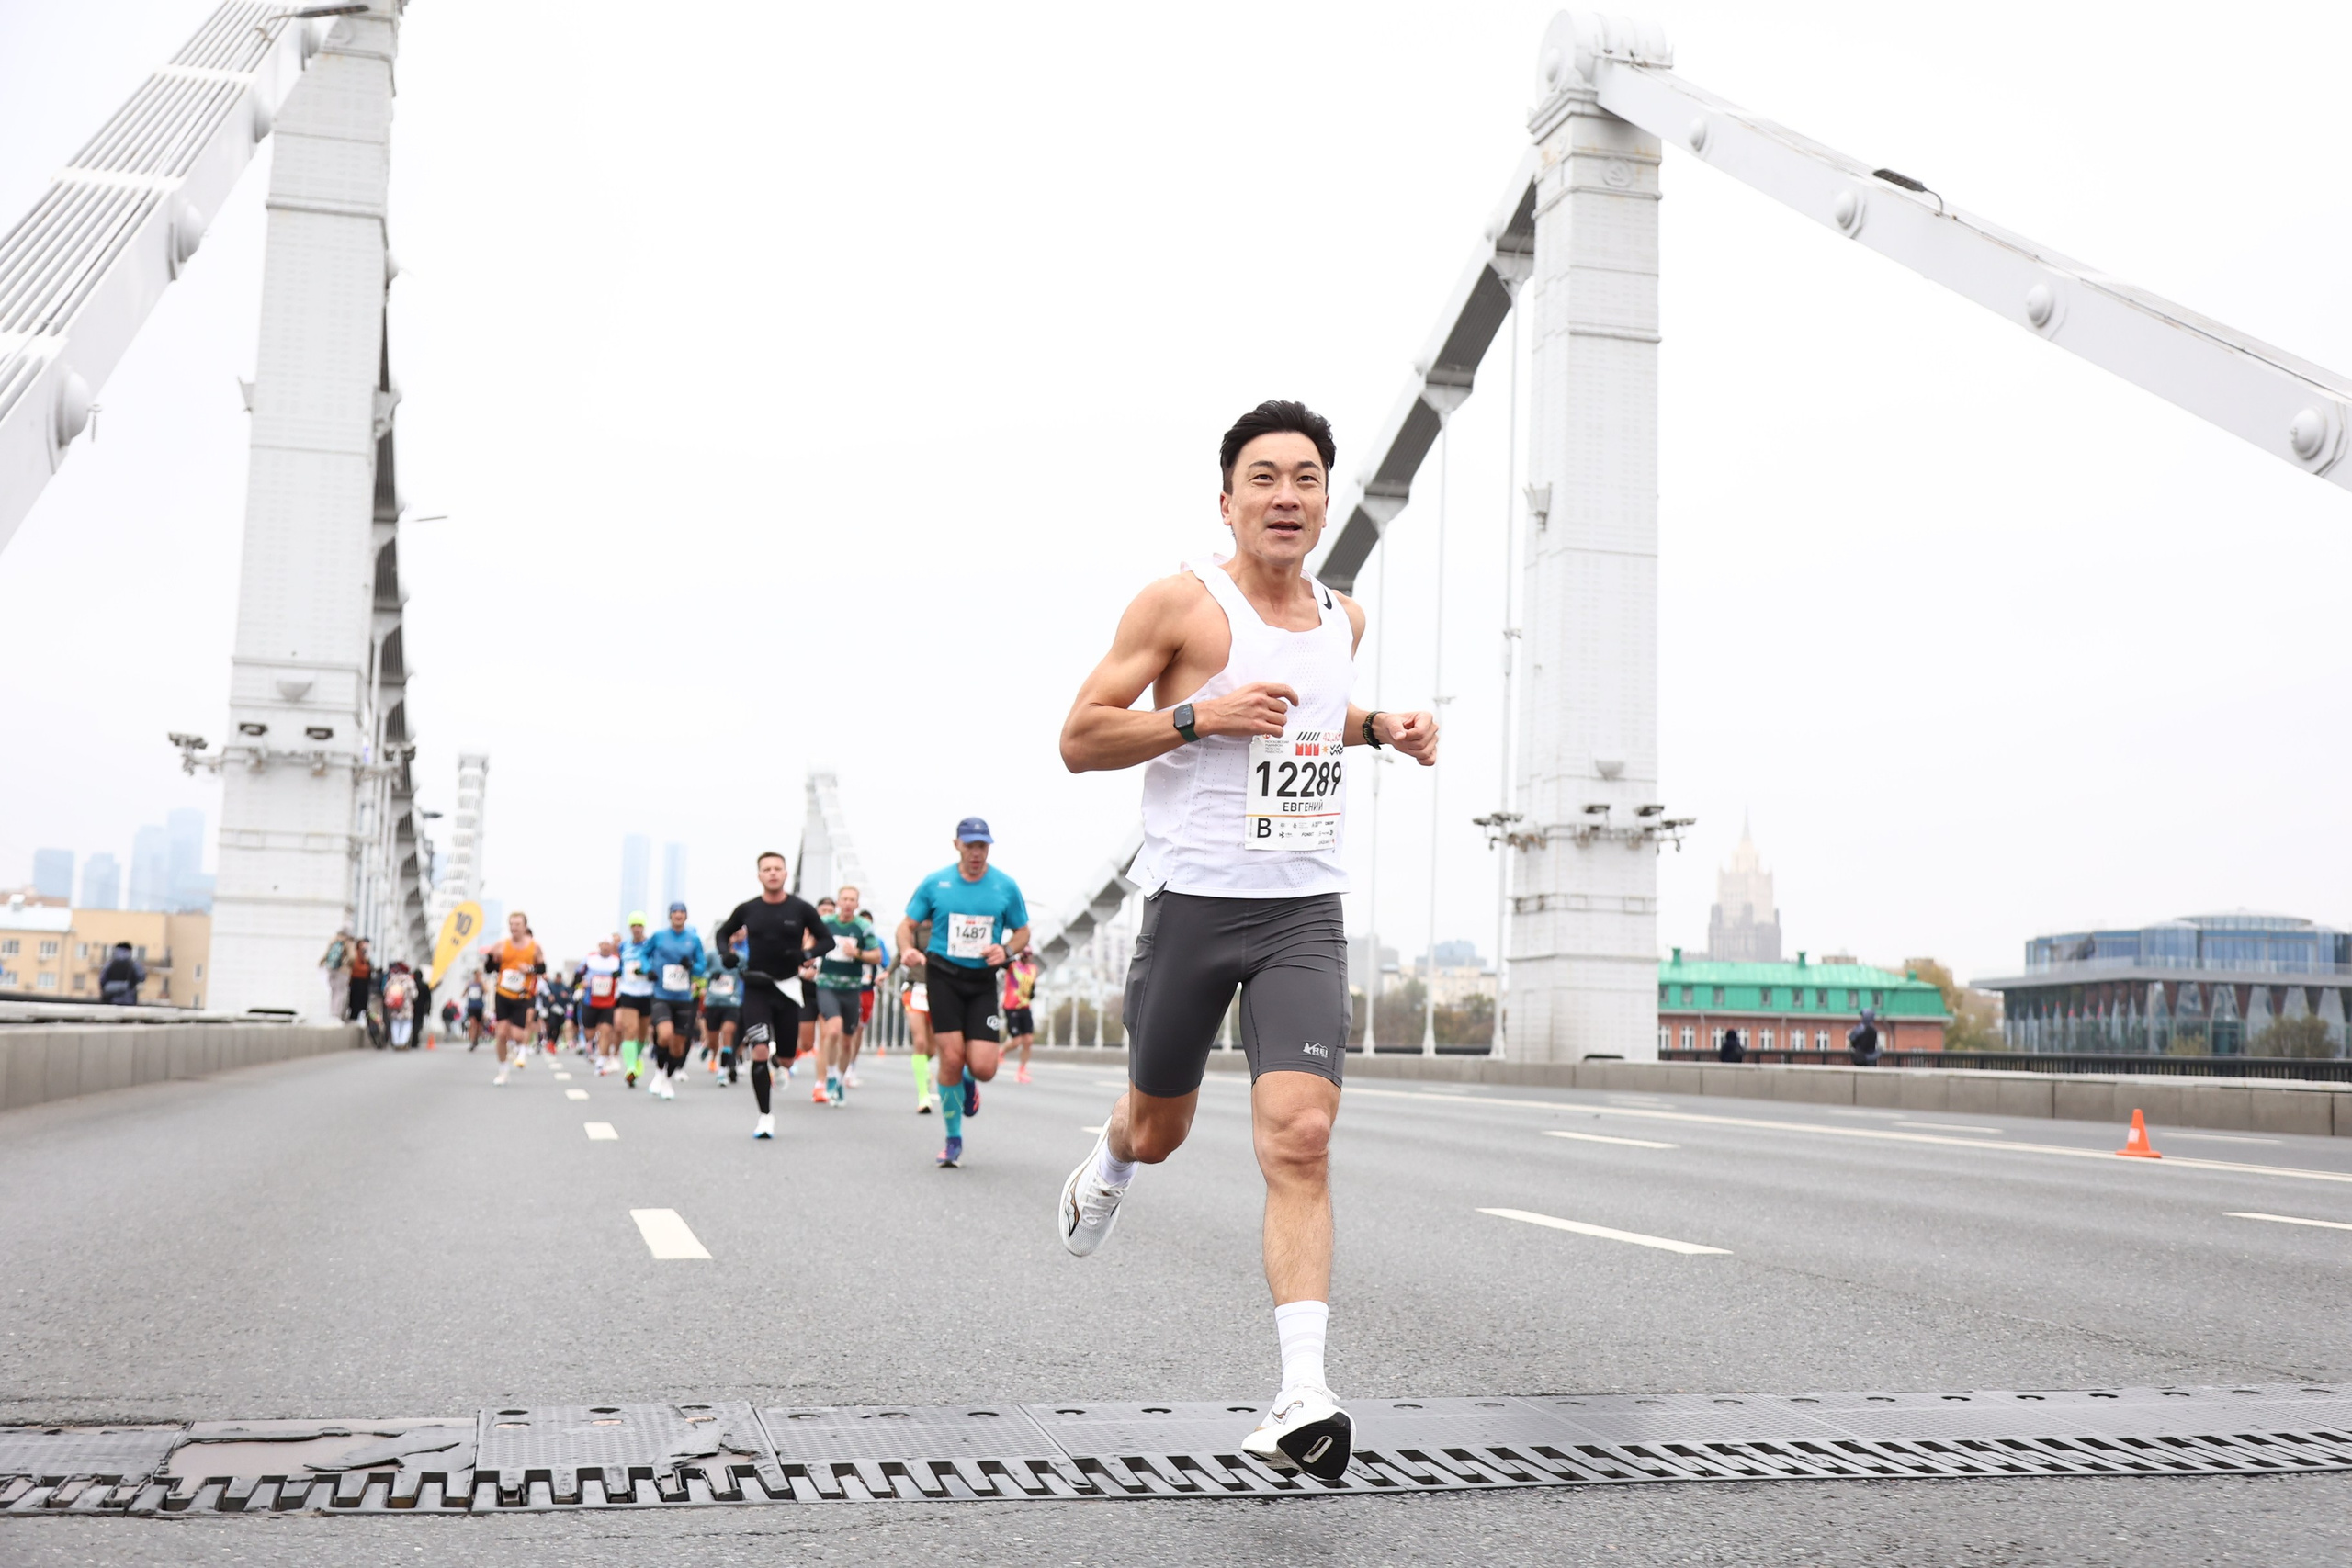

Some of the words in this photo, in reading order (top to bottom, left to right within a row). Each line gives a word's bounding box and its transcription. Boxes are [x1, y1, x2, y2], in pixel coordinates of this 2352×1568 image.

[1256, 761, 1341, 797] 12289
[1283, 799, 1323, 812] ЕВГЕНИЙ
[956, 926, 986, 939] 1487
